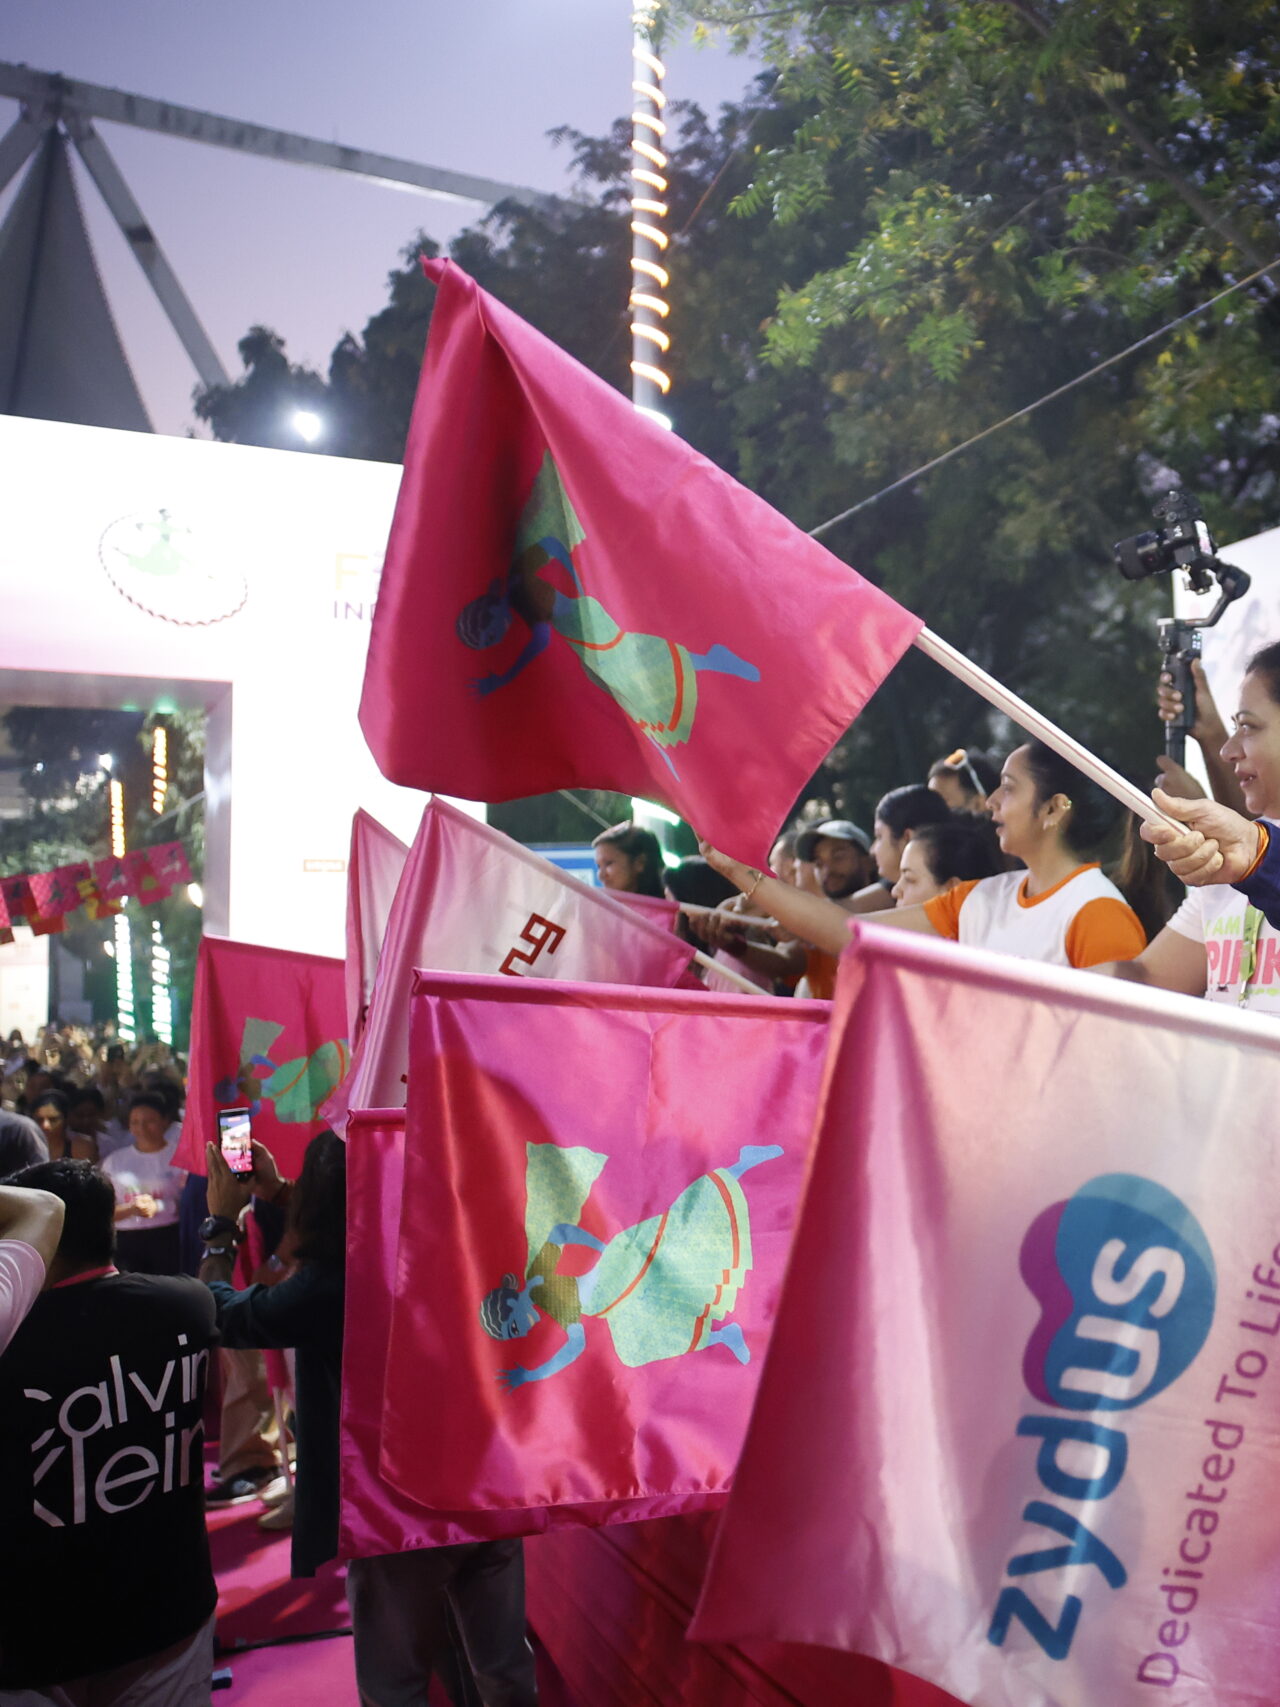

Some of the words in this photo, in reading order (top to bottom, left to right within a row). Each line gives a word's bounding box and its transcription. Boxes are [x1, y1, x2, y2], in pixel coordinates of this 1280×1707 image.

[1213, 915, 1240, 936] AM
[987, 1238, 1187, 1661] zydus
[1137, 1418, 1245, 1688] Dedicated
[1215, 1349, 1268, 1403] To
